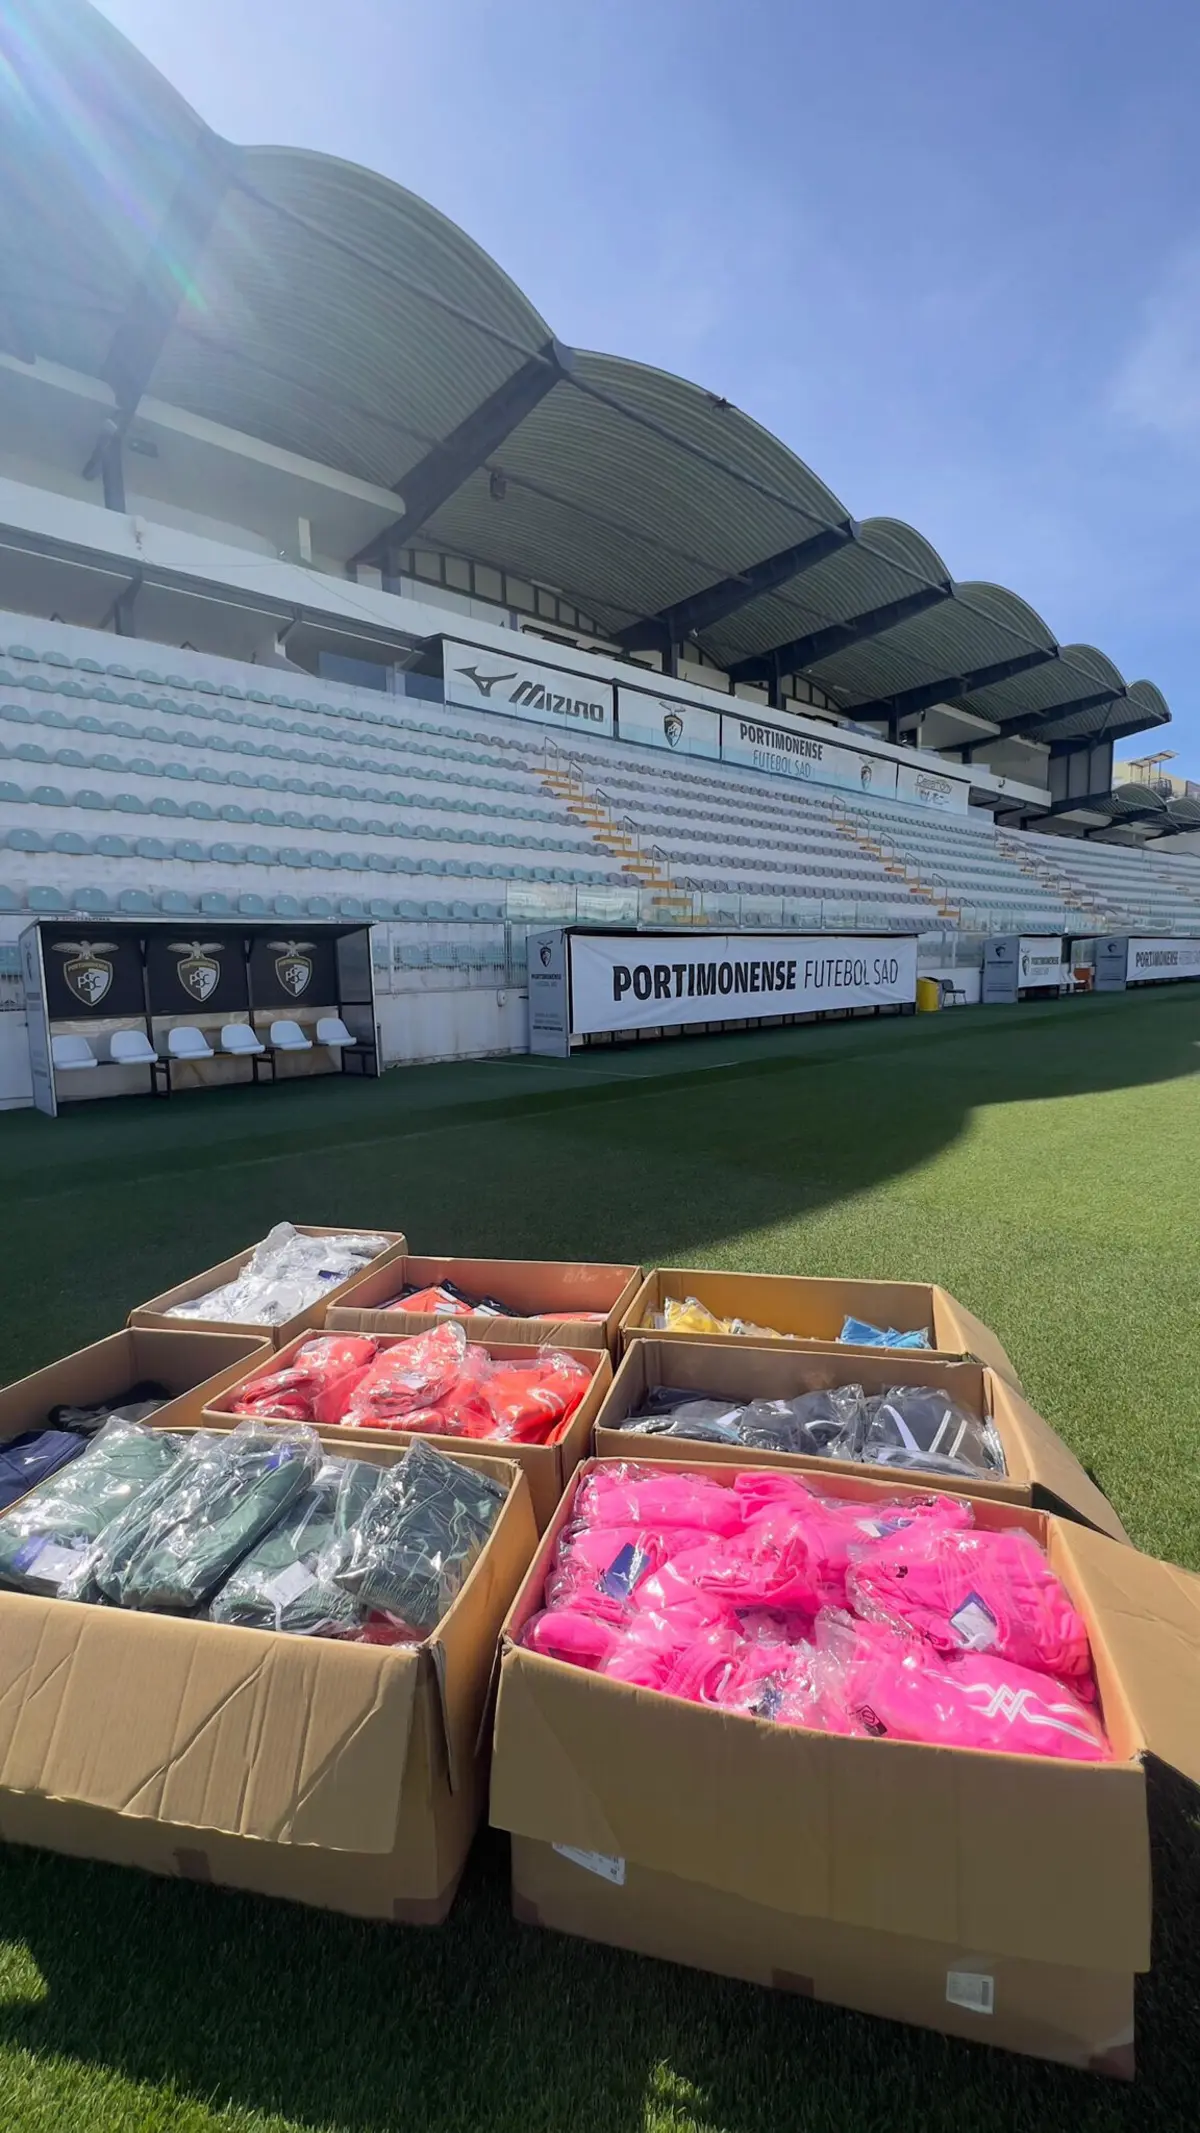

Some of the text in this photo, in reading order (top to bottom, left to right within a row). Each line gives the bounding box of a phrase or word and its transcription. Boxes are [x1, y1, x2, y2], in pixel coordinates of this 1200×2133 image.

[508, 681, 604, 722] MIZUNO
[740, 722, 823, 760] PORTIMONENSE
[753, 749, 812, 778] FUTEBOL SAD
[612, 958, 899, 1001] PORTIMONENSE FUTEBOL SAD
